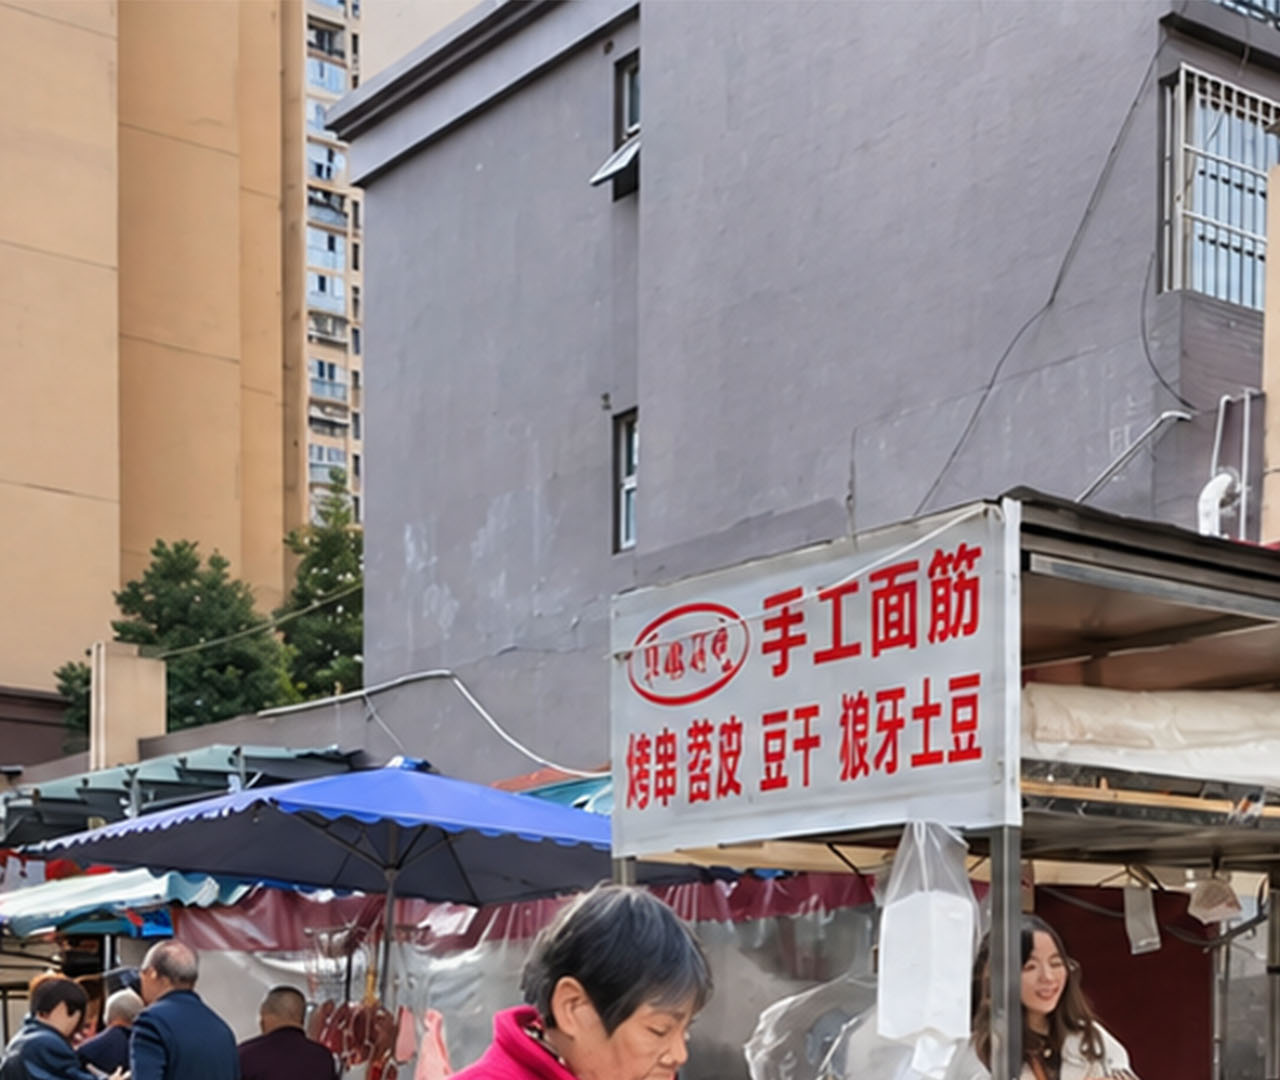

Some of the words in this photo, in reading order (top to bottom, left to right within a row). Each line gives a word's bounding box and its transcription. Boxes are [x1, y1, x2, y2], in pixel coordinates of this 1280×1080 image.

[761, 542, 982, 677] 手工面筋
[760, 704, 822, 792] 豆干
[840, 673, 982, 782] 狼牙土豆
